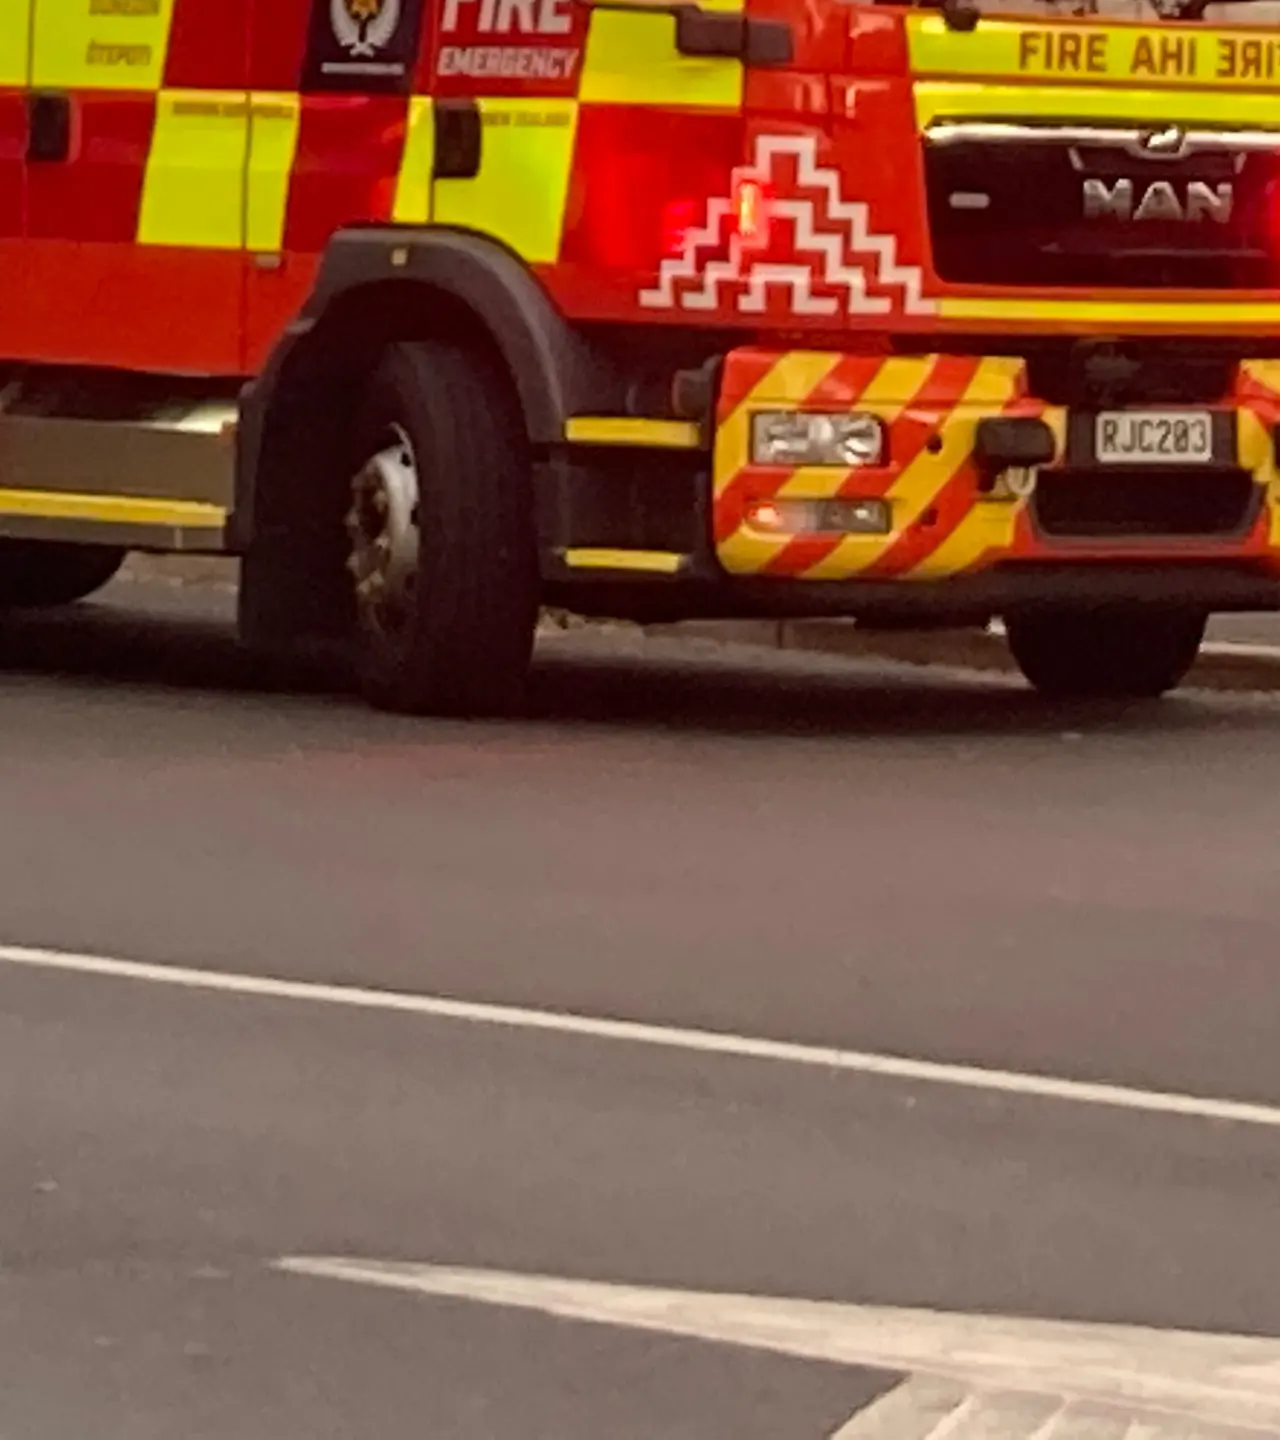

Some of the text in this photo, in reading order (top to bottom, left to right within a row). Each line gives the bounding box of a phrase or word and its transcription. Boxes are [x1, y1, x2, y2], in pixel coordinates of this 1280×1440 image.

[437, 45, 580, 79] EMERGENCY
[1019, 31, 1199, 77] FIRE AHI
[1083, 178, 1233, 224] MAN
[1102, 418, 1207, 454] RJC203
